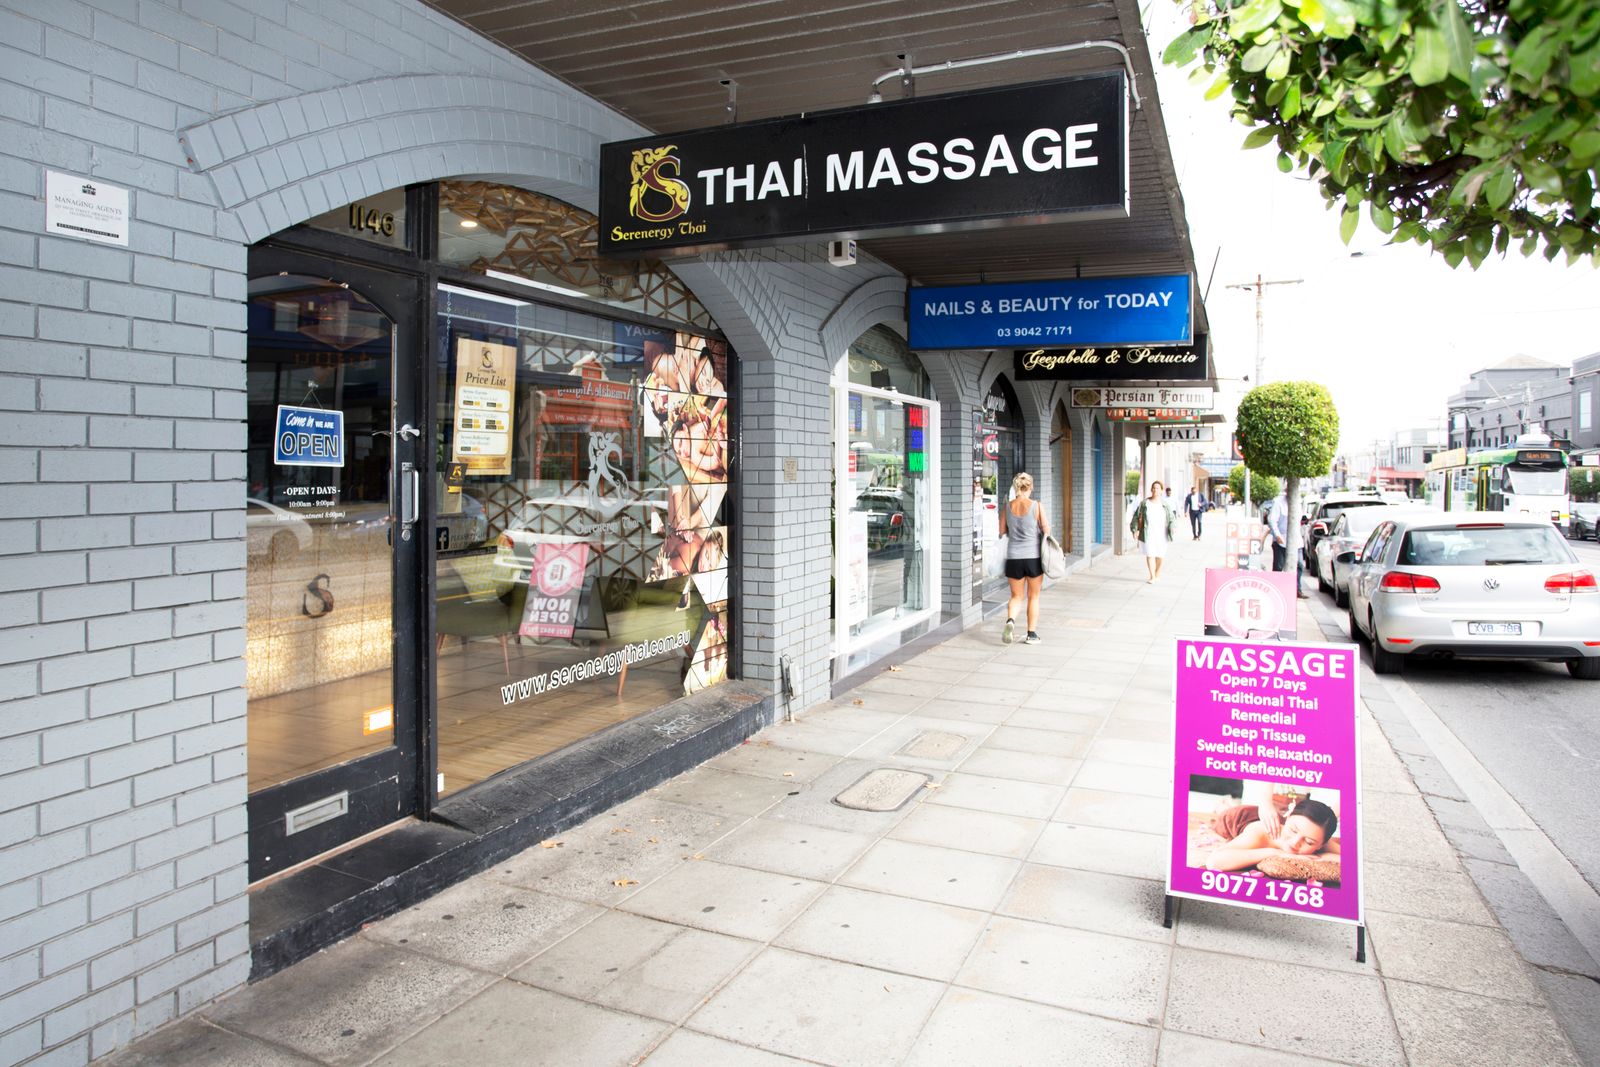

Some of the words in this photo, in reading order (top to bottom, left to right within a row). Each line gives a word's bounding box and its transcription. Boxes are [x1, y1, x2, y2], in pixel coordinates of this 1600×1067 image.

[697, 157, 803, 206] THAI
[826, 123, 1099, 193] MASSAGE
[54, 195, 94, 210] MANAGING
[96, 205, 123, 216] AGENTS
[349, 203, 396, 237] 1146
[610, 225, 675, 242] Serenergy
[678, 222, 707, 236] Thai
[924, 300, 976, 317] NAILS
[980, 299, 993, 315] &
[999, 296, 1073, 314] BEAUTY
[1077, 297, 1100, 311] for
[1104, 291, 1173, 310] TODAY
[997, 328, 1011, 338] 03
[1014, 327, 1042, 337] 9042
[1045, 326, 1073, 336] 7171
[1022, 348, 1100, 371] Geezabella
[1105, 350, 1120, 364] &
[1126, 348, 1200, 365] Petrucio
[465, 371, 489, 385] Price
[490, 375, 507, 387] List
[1105, 389, 1155, 406] Persian
[1158, 389, 1205, 405] Forum
[285, 412, 306, 427] Come
[315, 420, 323, 428] WE
[324, 421, 334, 429] ARE
[280, 431, 339, 458] OPEN
[1161, 429, 1200, 440] HALI
[311, 487, 315, 495] 7
[315, 500, 335, 508] 9:00pm
[1236, 598, 1261, 621] 15
[500, 629, 691, 705] www.serenergythai.com.au
[1184, 644, 1347, 679] MASSAGE
[1220, 673, 1258, 691] Open
[1260, 676, 1270, 689] 7
[1273, 677, 1307, 693] Days
[1210, 689, 1284, 708] Traditional
[1287, 693, 1319, 711] Thai
[1230, 708, 1297, 726] Remedial
[1221, 724, 1258, 742] Deep
[1261, 727, 1306, 744] Tissue
[1196, 738, 1254, 757] Swedish
[1256, 745, 1333, 765] Relaxation
[1205, 756, 1237, 772] Foot
[1240, 760, 1323, 784] Reflexology
[1200, 871, 1258, 898] 9077
[1265, 881, 1325, 908] 1768
